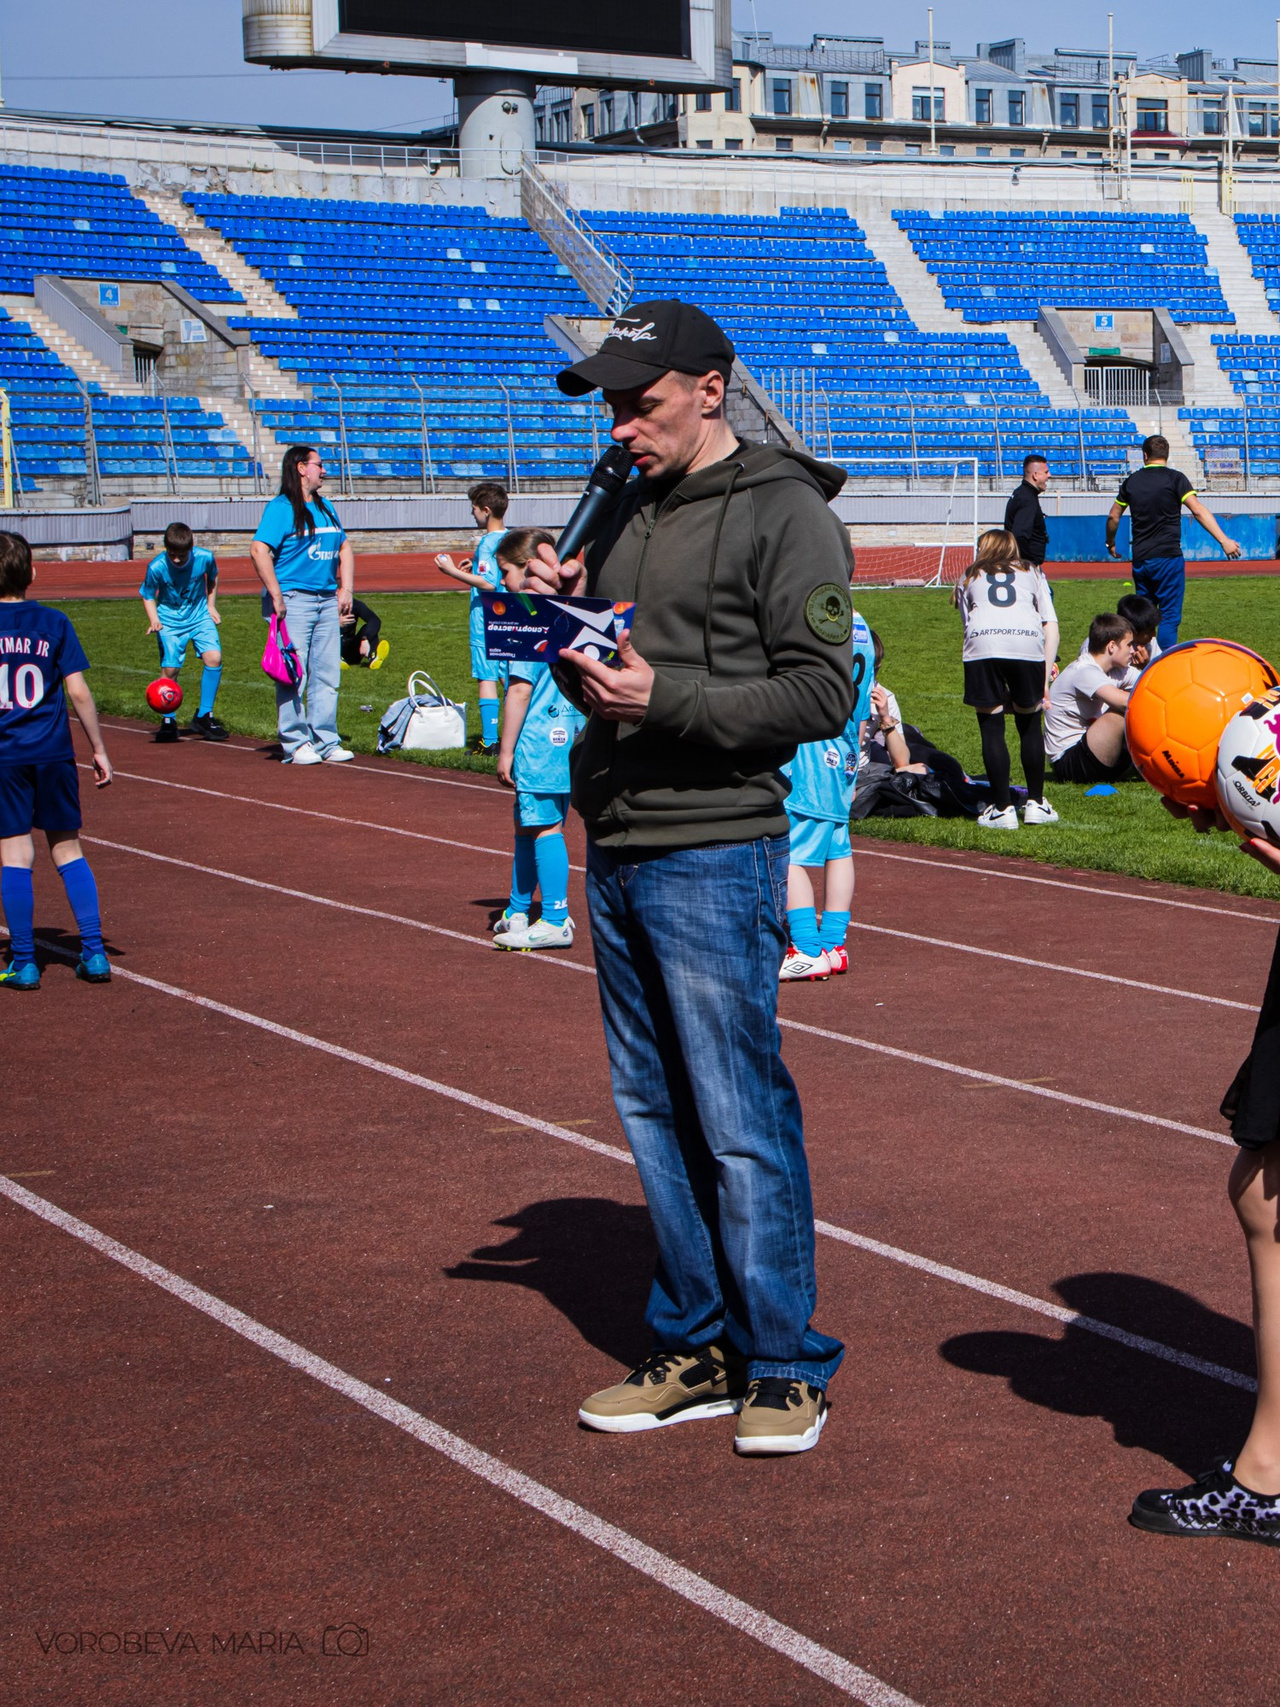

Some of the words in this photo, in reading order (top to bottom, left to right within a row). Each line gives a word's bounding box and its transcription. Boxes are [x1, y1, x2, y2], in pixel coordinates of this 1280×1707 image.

[105, 289, 114, 300] 4
[1100, 316, 1108, 327] 5
[985, 572, 1017, 608] 8
[980, 628, 1039, 638] ARTSPORT.SPB.RU
[35, 640, 50, 658] JR
[0, 663, 44, 710] 10
